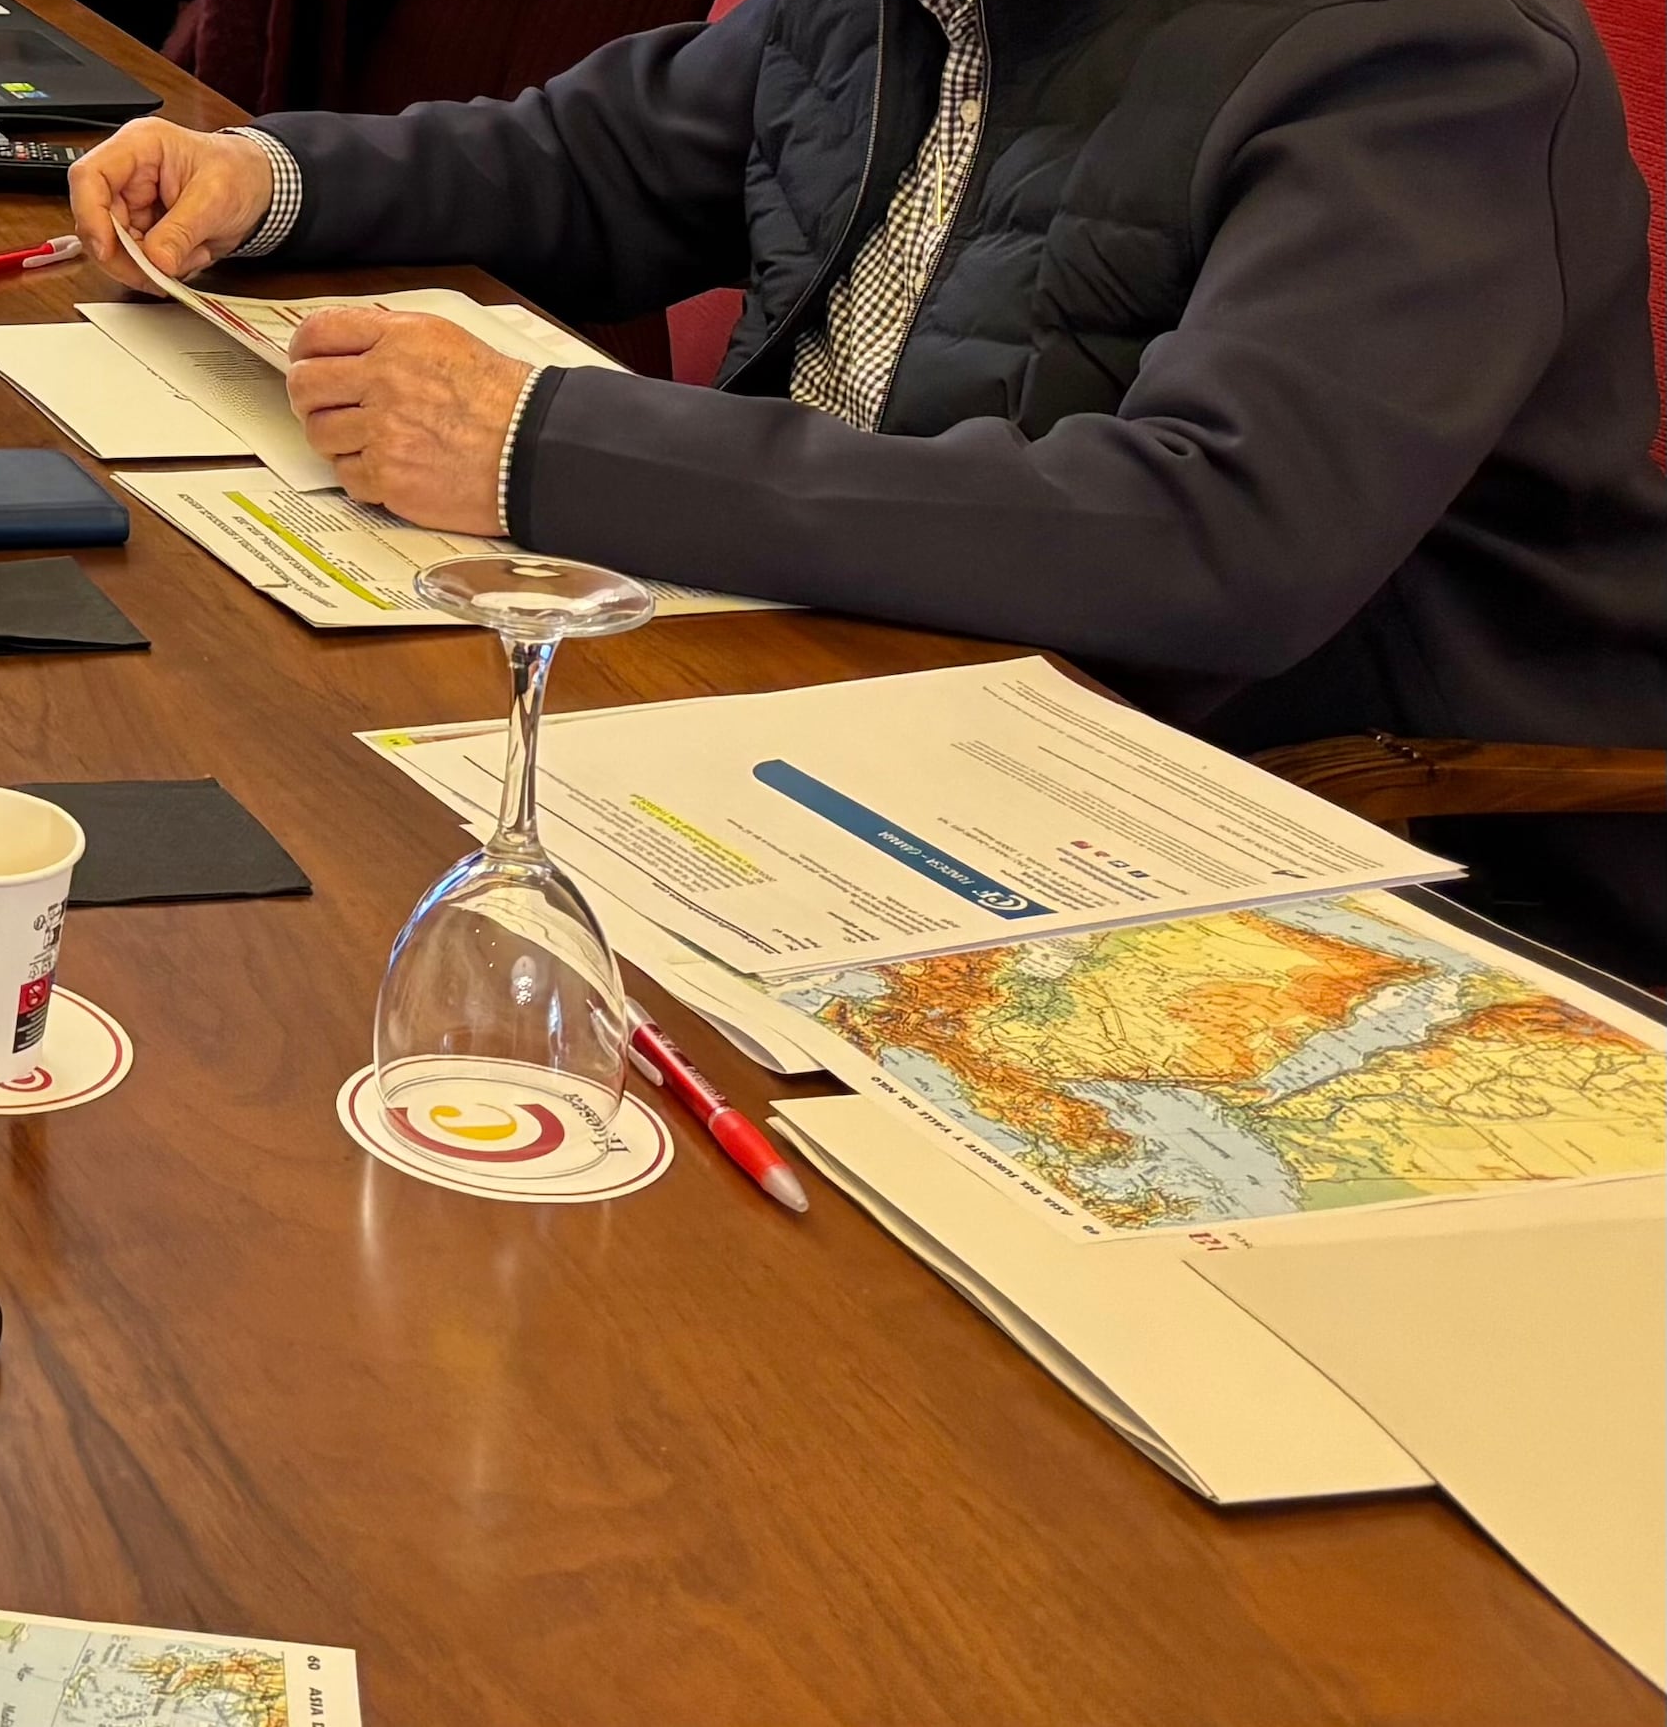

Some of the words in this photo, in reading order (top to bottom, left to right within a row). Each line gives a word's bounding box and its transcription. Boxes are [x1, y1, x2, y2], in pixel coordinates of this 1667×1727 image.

[871, 1076, 899, 1094] NILO
[898, 1095, 918, 1110] DEL
[917, 1110, 952, 1133] VALLE
[964, 1143, 1020, 1179] SUROESTE
[1019, 1180, 1043, 1195] DEL
[1043, 1196, 1075, 1216] ASIA
[307, 1656, 321, 1670] 60
[309, 1687, 323, 1715] ASIA
